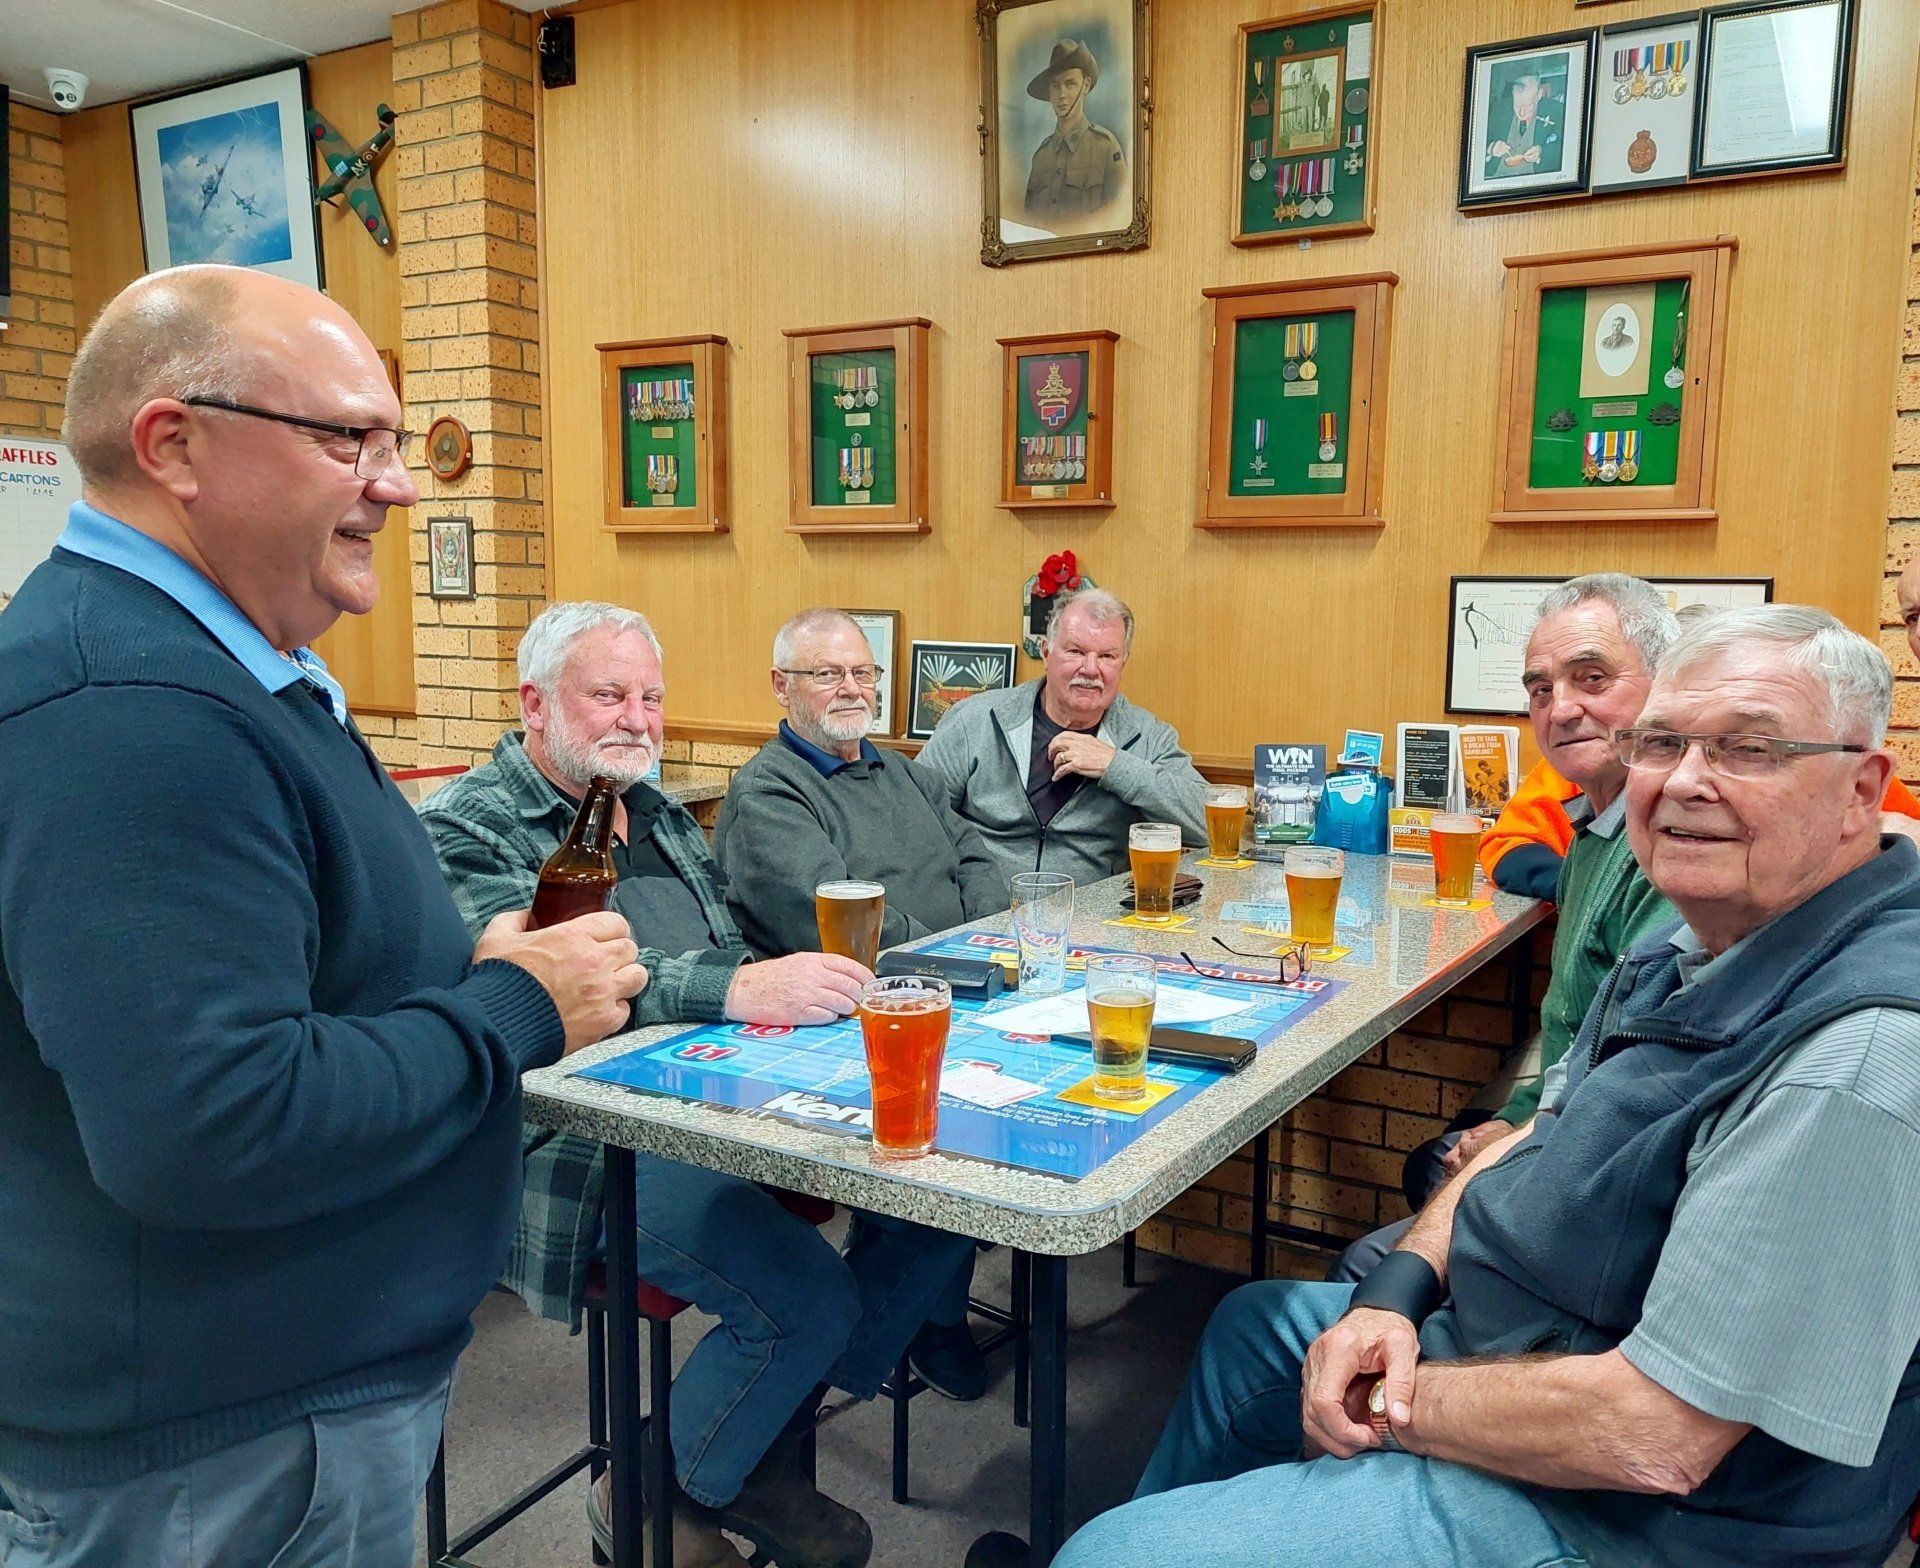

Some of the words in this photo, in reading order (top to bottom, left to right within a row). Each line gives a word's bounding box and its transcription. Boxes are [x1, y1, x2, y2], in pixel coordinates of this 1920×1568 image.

[350, 158, 368, 177] AK
[0, 447, 57, 466] AFFLES
[0, 471, 61, 486] CARTONS
[1267, 747, 1313, 765] WIN
[676, 1042, 739, 1061] 11
[760, 1091, 873, 1129] Ken
